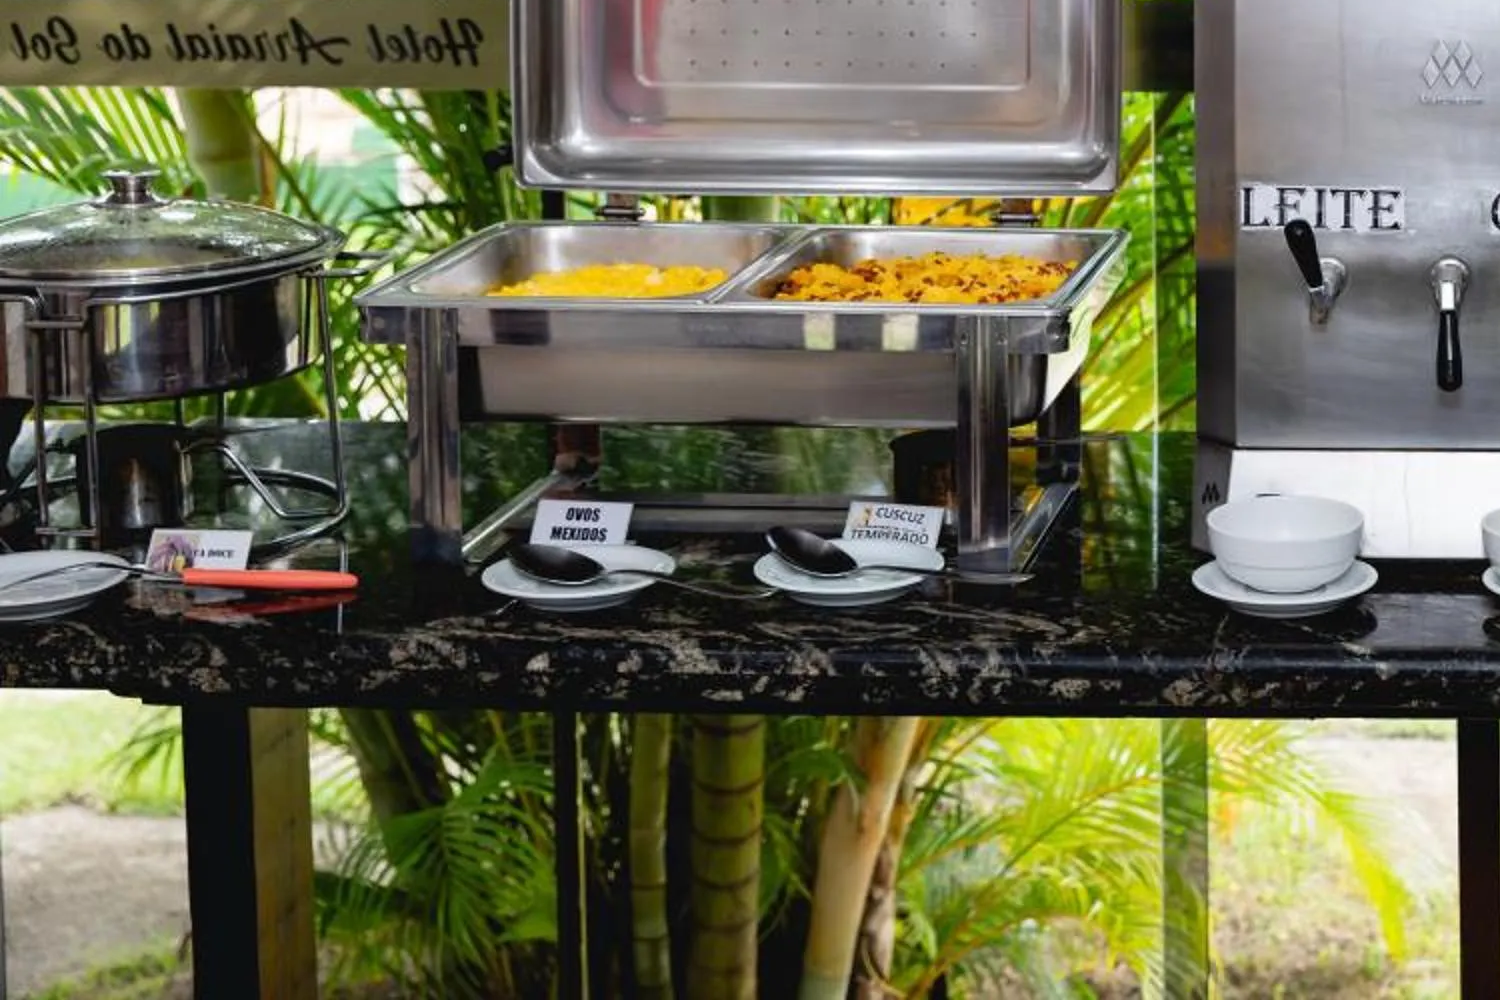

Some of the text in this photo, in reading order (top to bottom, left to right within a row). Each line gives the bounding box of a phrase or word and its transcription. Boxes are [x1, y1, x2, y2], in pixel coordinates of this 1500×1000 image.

[1241, 187, 1402, 230] LEITE
[565, 507, 601, 522] OVOS
[875, 507, 926, 524] CUSCUZ
[550, 526, 608, 542] MEXIDOS
[850, 529, 930, 545] TEMPERADO
